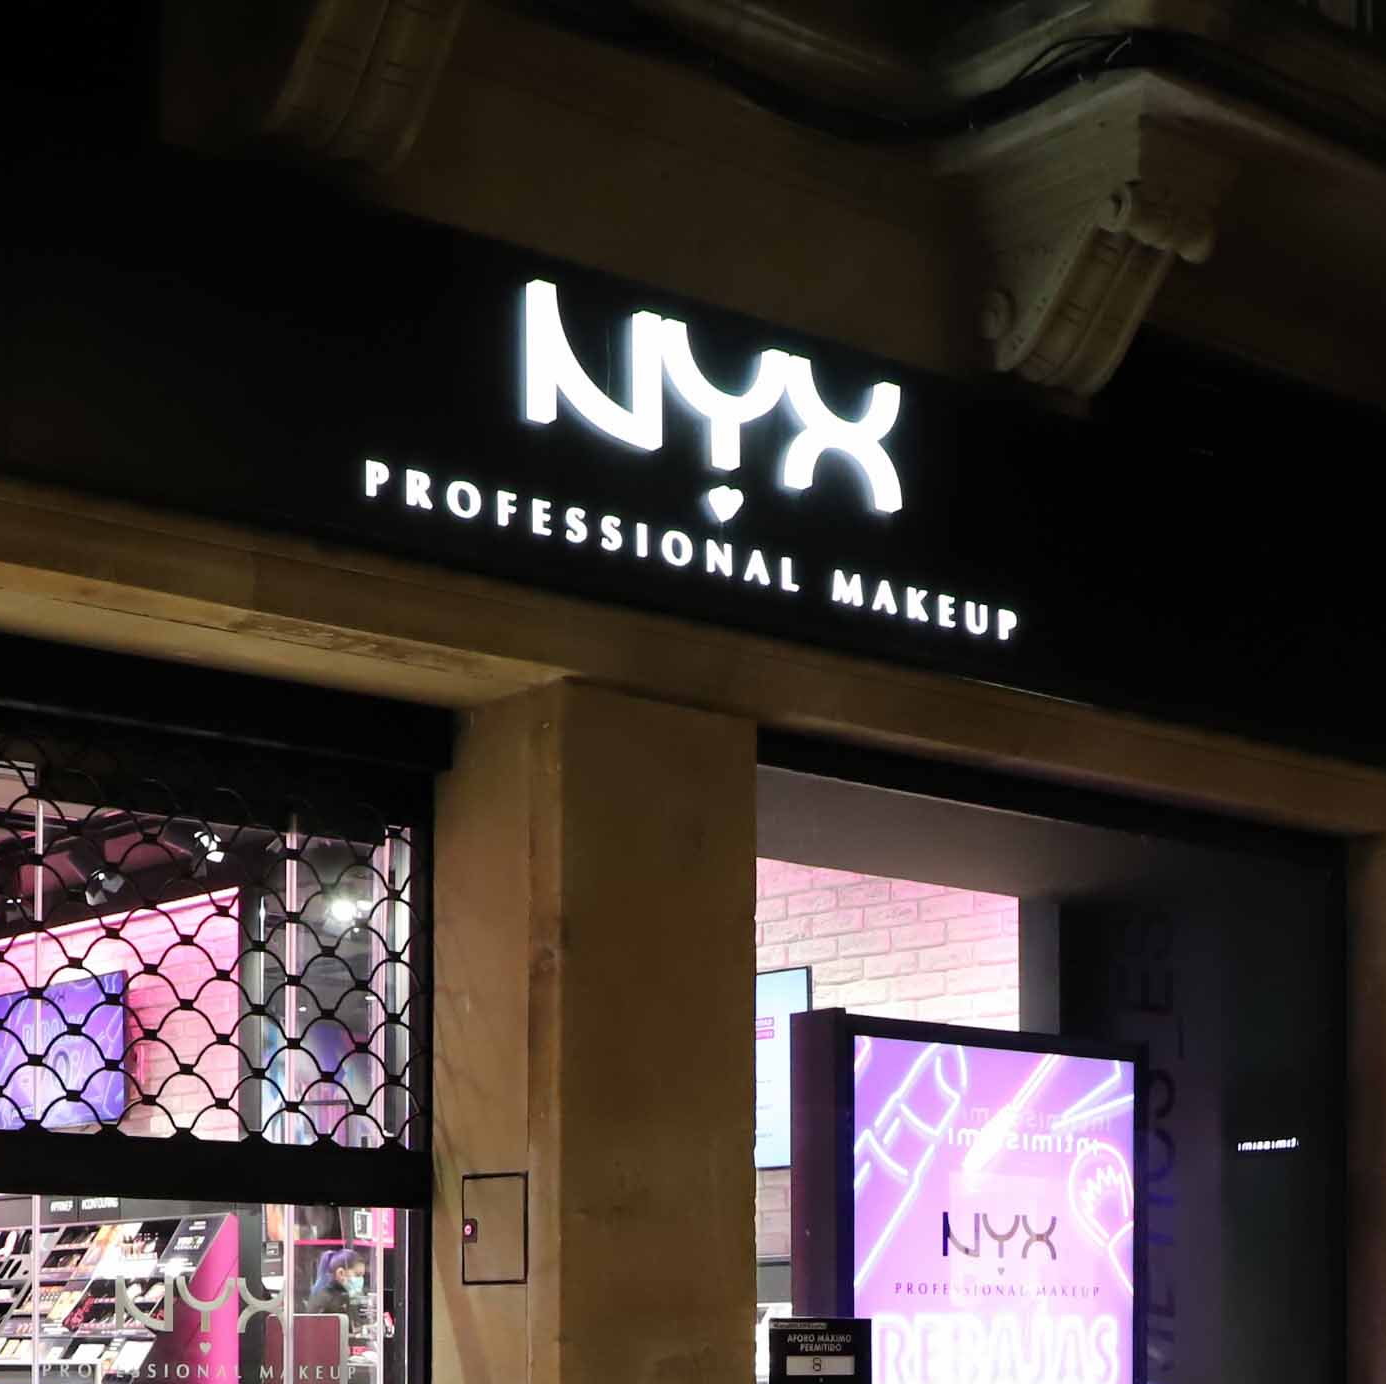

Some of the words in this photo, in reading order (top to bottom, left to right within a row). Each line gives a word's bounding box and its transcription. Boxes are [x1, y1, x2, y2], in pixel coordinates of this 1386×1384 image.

[524, 278, 903, 513] NYX
[364, 459, 800, 593] PROFESSIONAL
[831, 569, 1019, 641] MAKEUP
[942, 1210, 1057, 1260] NYX
[1036, 1284, 1101, 1298] MAKEUP
[787, 1334, 815, 1344] AFORO
[817, 1332, 852, 1343] MÁXIMO
[799, 1344, 842, 1353] PERMITIDO
